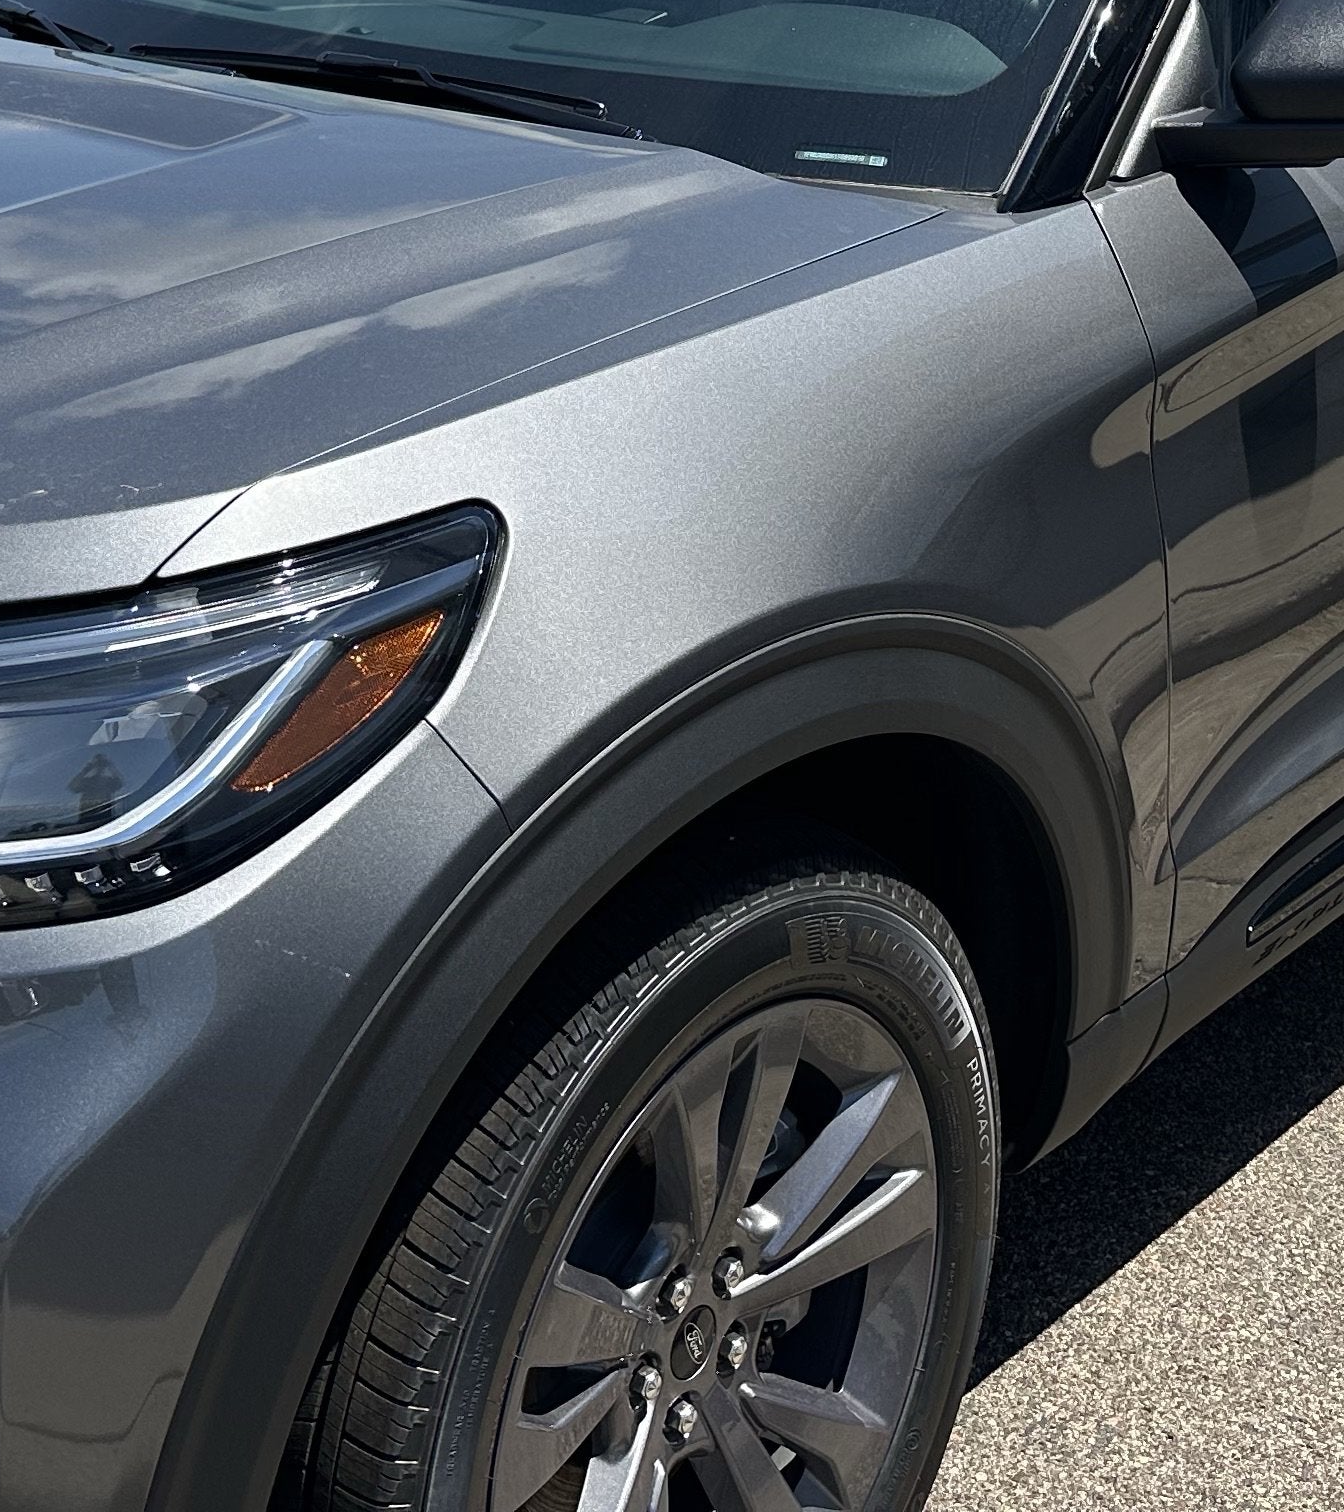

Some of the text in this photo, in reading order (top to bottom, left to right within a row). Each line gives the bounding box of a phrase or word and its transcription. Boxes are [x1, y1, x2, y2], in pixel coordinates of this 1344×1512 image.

[853, 925, 966, 1045] MICHELIN
[966, 1056, 993, 1168] PRIMACY
[686, 1329, 703, 1359] Ford
